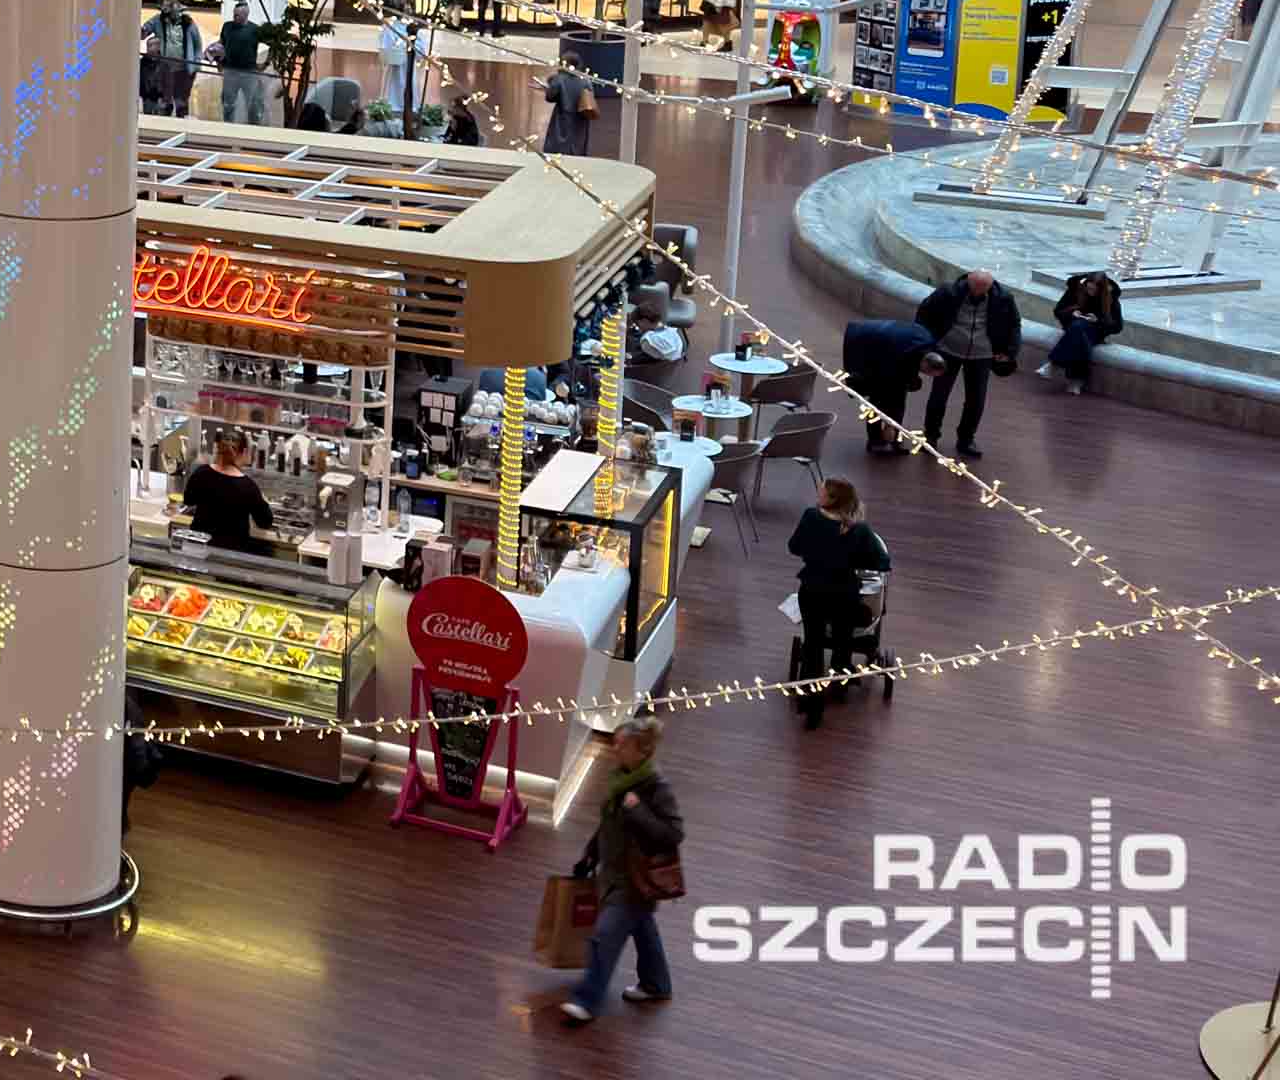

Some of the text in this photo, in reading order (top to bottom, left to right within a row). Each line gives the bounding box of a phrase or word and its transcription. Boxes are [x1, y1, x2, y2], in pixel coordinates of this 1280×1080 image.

[1041, 9, 1059, 25] +1
[134, 246, 316, 323] tellari
[421, 611, 514, 651] Castellari
